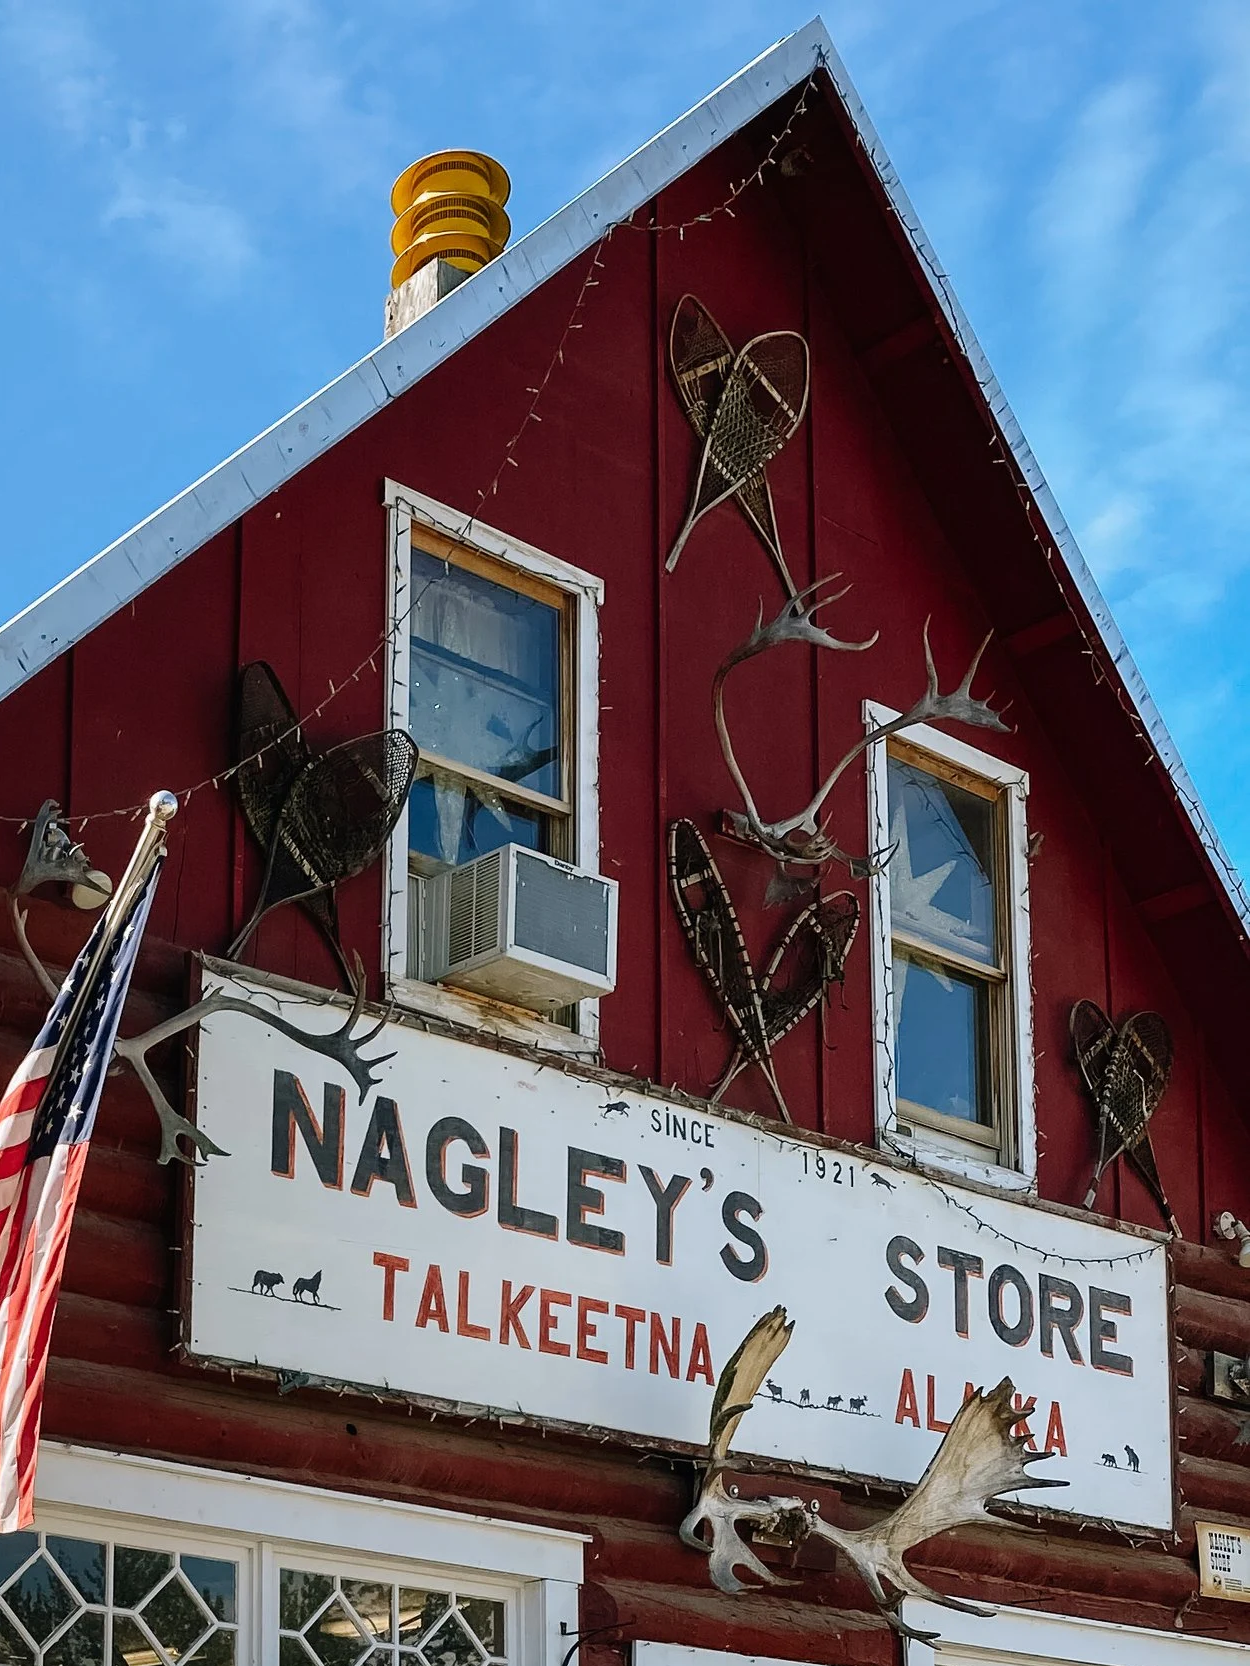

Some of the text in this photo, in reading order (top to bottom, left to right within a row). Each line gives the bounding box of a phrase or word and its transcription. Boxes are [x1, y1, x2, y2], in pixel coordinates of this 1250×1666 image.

[271, 1068, 1134, 1378] NAGLEY'S STORE
[802, 1151, 855, 1188] 1921
[372, 1251, 1067, 1457] TALKEETNA ALKA
